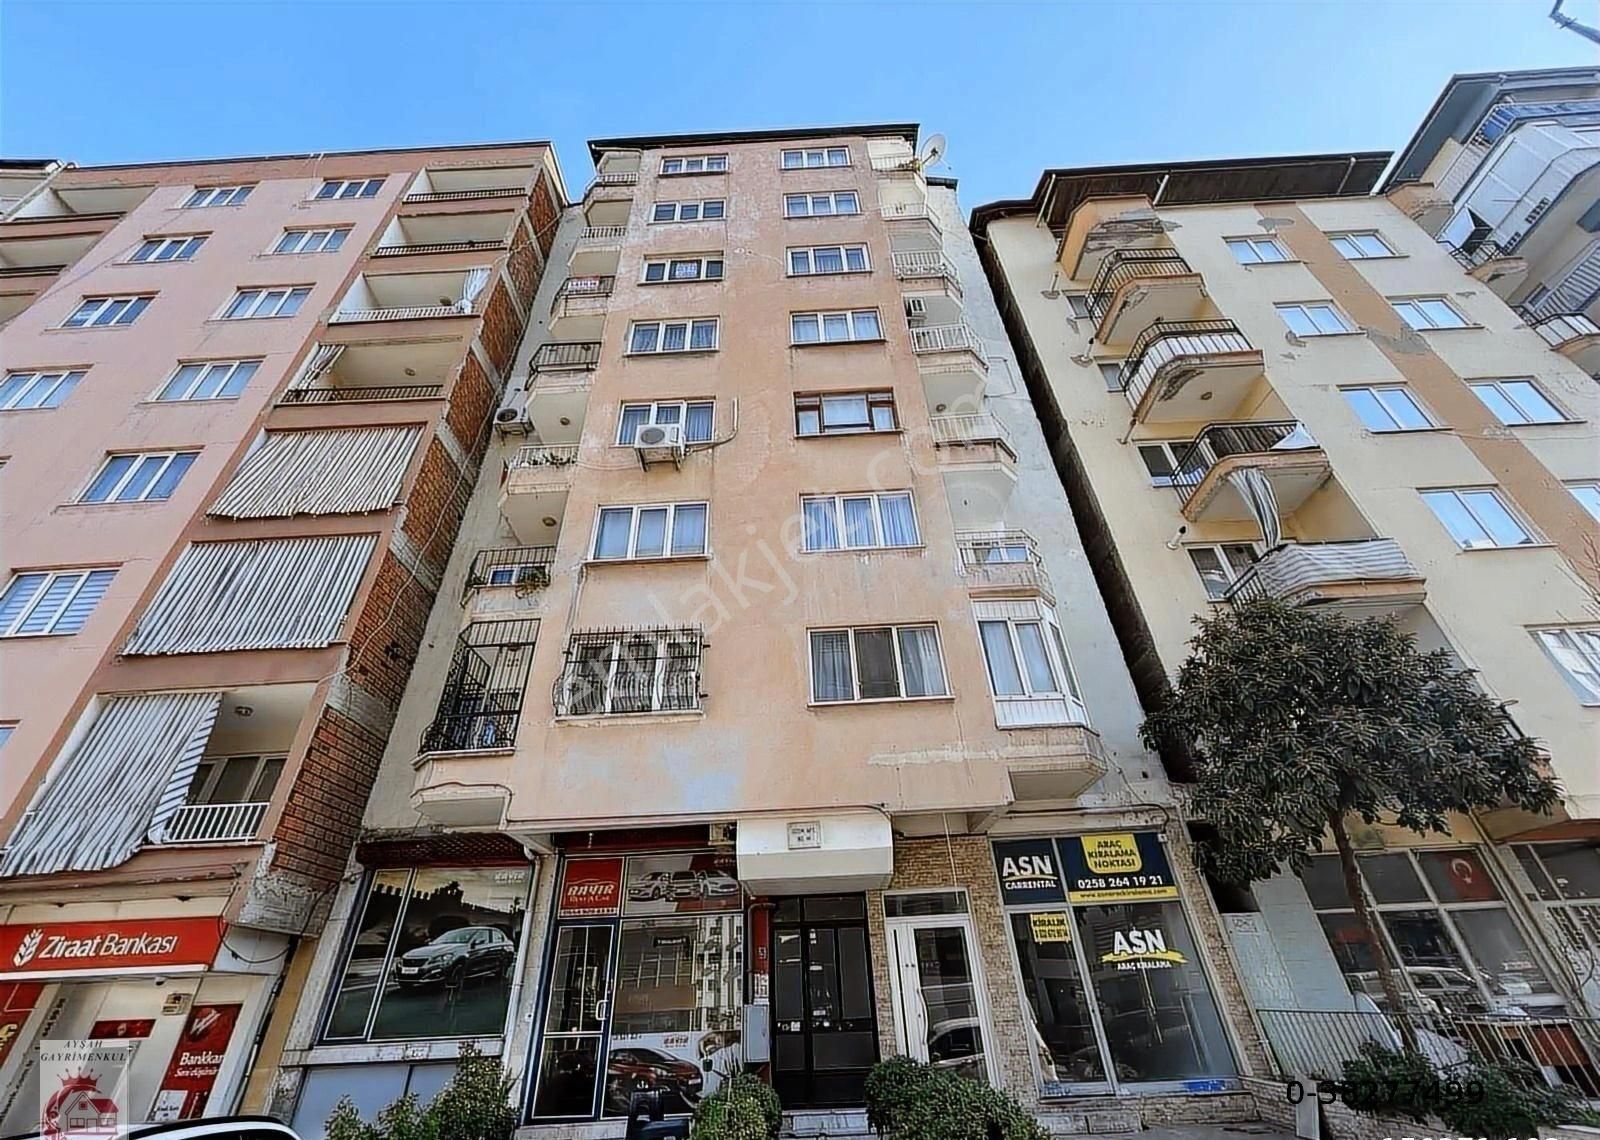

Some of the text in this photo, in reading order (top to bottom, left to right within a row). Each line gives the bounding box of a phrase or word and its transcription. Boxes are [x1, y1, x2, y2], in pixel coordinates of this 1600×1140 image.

[1097, 840, 1122, 849] ARAÇ
[1002, 855, 1053, 877] ASN
[1094, 858, 1136, 869] NOKTASI
[1077, 874, 1163, 889] 0258 264 19 21
[38, 932, 178, 958] Ziraat Bankası
[1113, 929, 1167, 954] ASN
